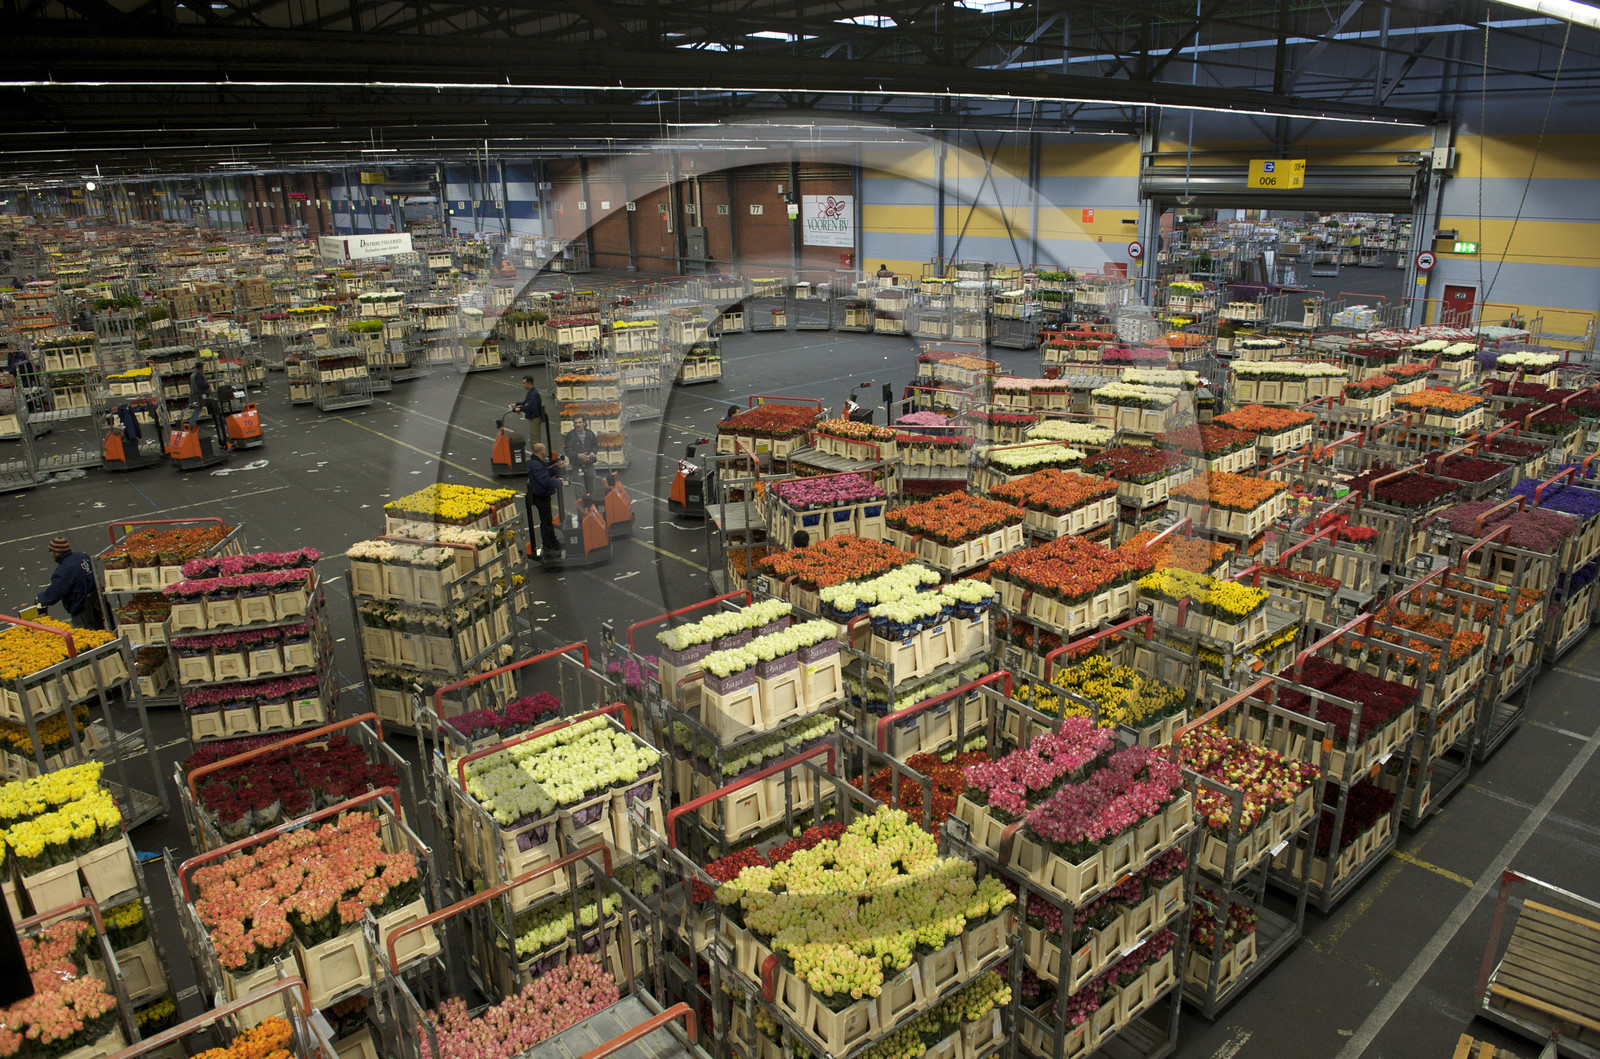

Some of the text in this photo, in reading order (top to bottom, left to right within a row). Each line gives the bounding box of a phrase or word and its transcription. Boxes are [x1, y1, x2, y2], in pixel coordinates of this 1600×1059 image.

[1259, 177, 1277, 186] 006
[686, 204, 694, 212] 75
[719, 205, 727, 213] 76
[752, 205, 760, 214] 77
[807, 218, 848, 231] VOOREN BV
